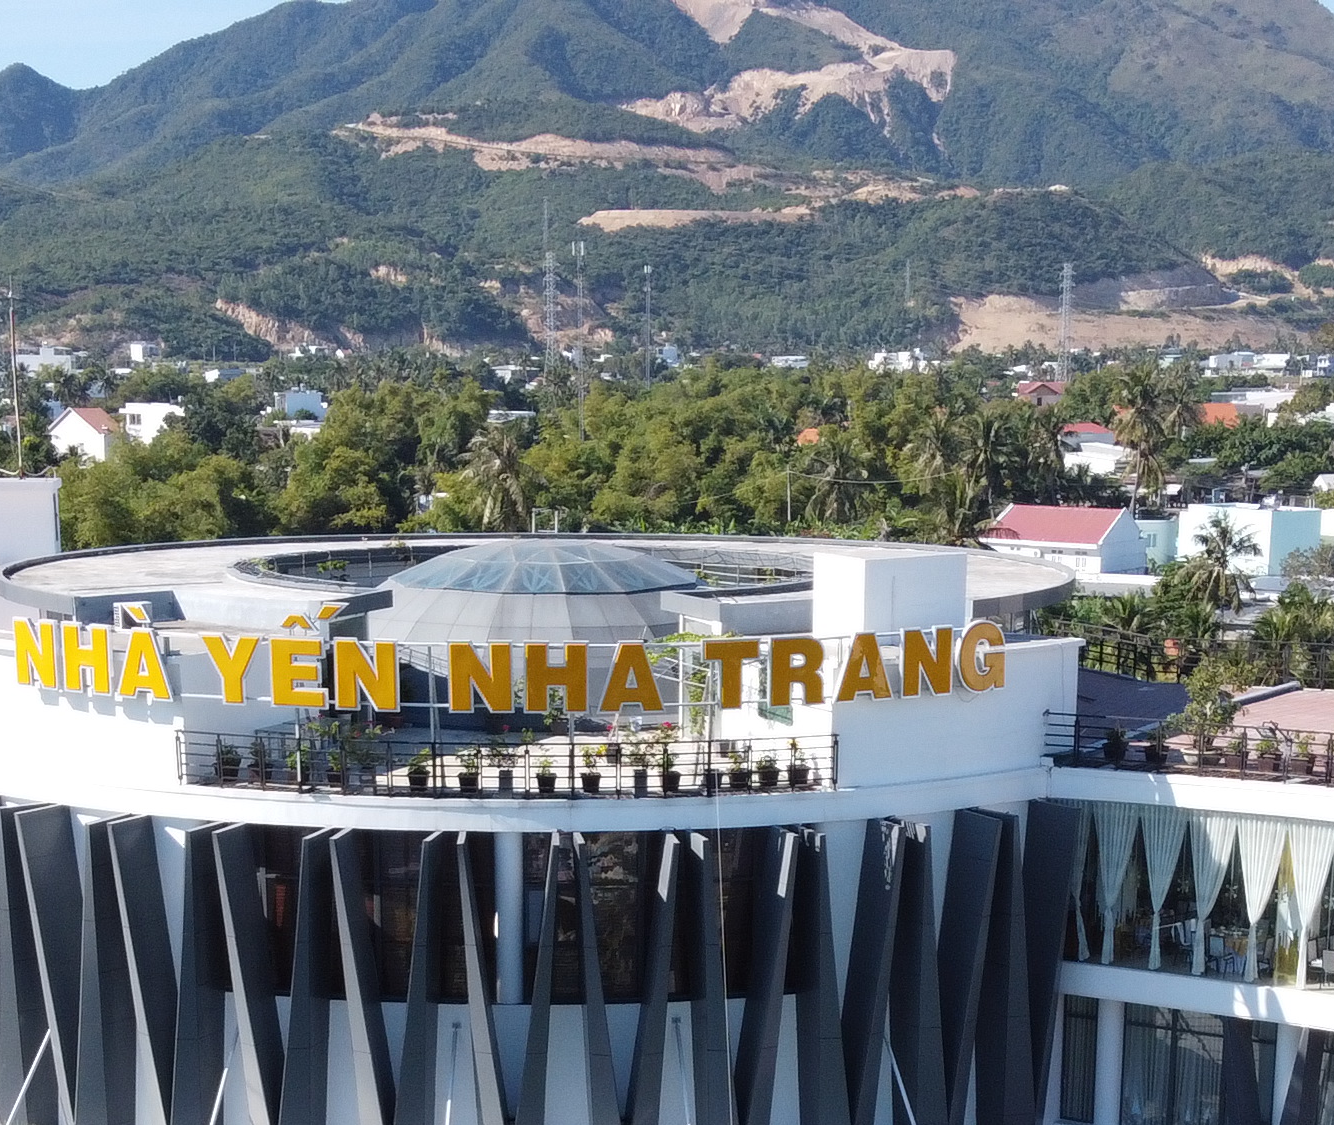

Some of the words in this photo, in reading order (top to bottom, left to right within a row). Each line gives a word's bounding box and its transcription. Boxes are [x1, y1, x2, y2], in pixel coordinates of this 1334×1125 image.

[13, 603, 173, 702] NHÀ
[200, 603, 400, 712] YẾN
[447, 639, 665, 715] NHA
[702, 619, 1007, 710] TRANG
